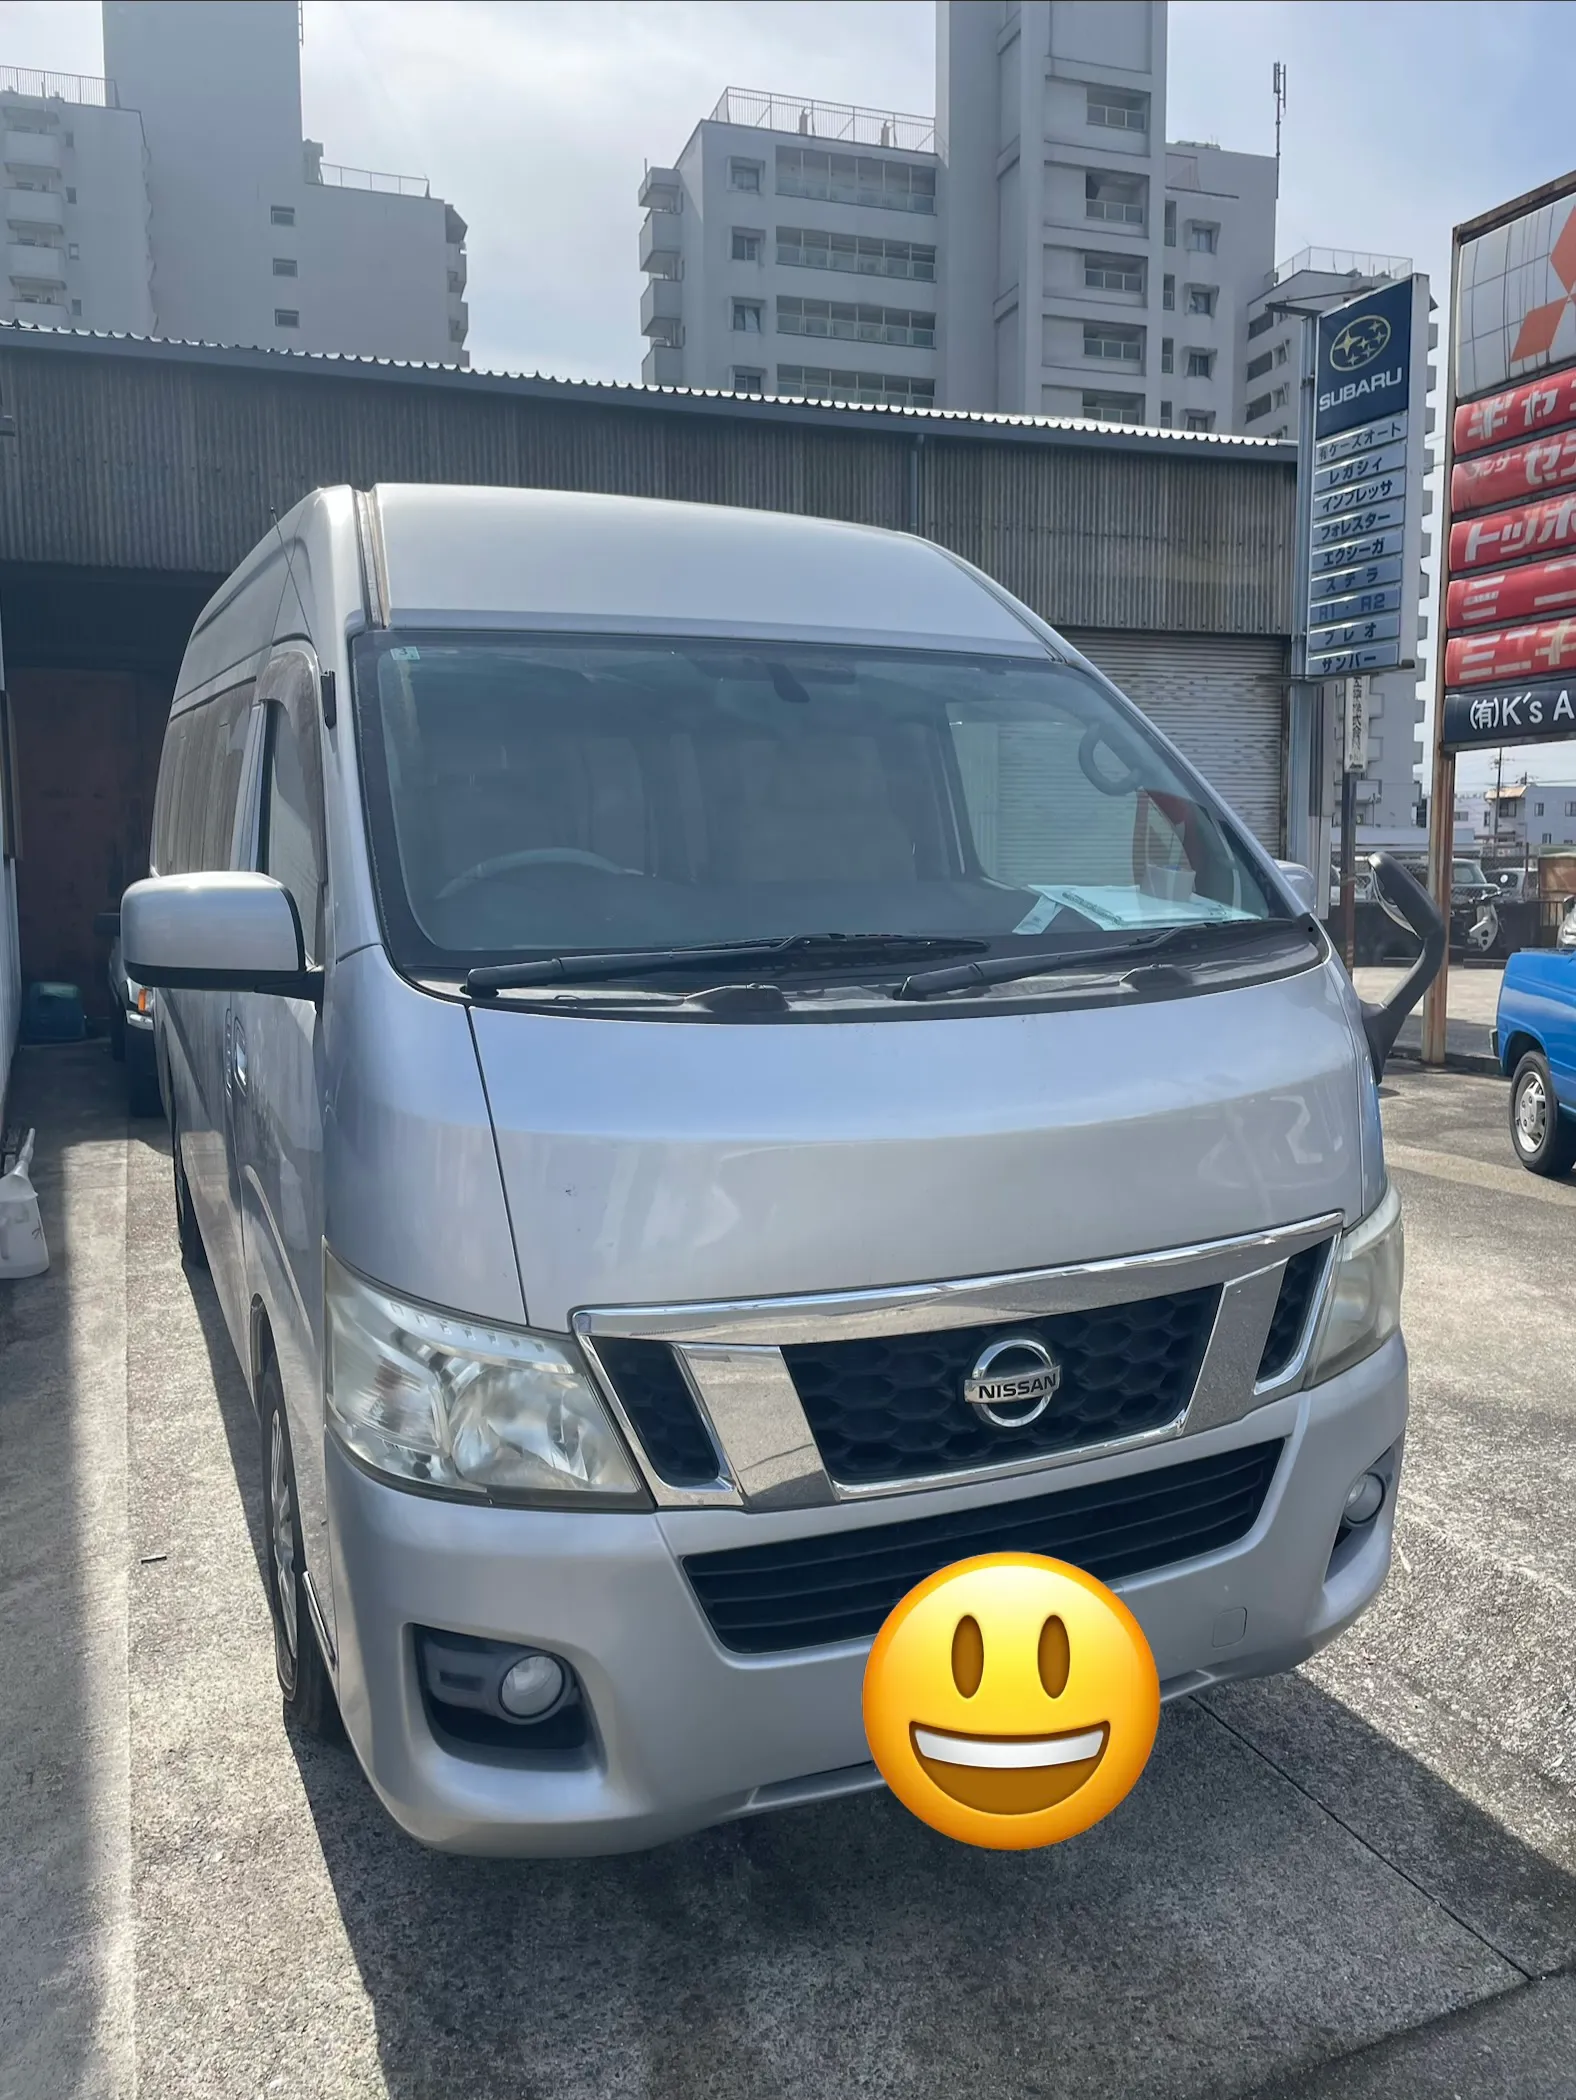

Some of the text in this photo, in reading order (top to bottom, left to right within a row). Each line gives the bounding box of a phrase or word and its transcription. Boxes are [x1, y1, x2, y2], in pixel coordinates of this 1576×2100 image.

[1318, 367, 1403, 412] SUBARU
[1467, 379, 1576, 441] ギャ
[1321, 512, 1391, 541] フォレスター
[1323, 537, 1386, 566] エクシーガ
[1325, 567, 1379, 593] ステラ
[1321, 651, 1377, 673] サンバー
[978, 1373, 1056, 1399] NISSAN
